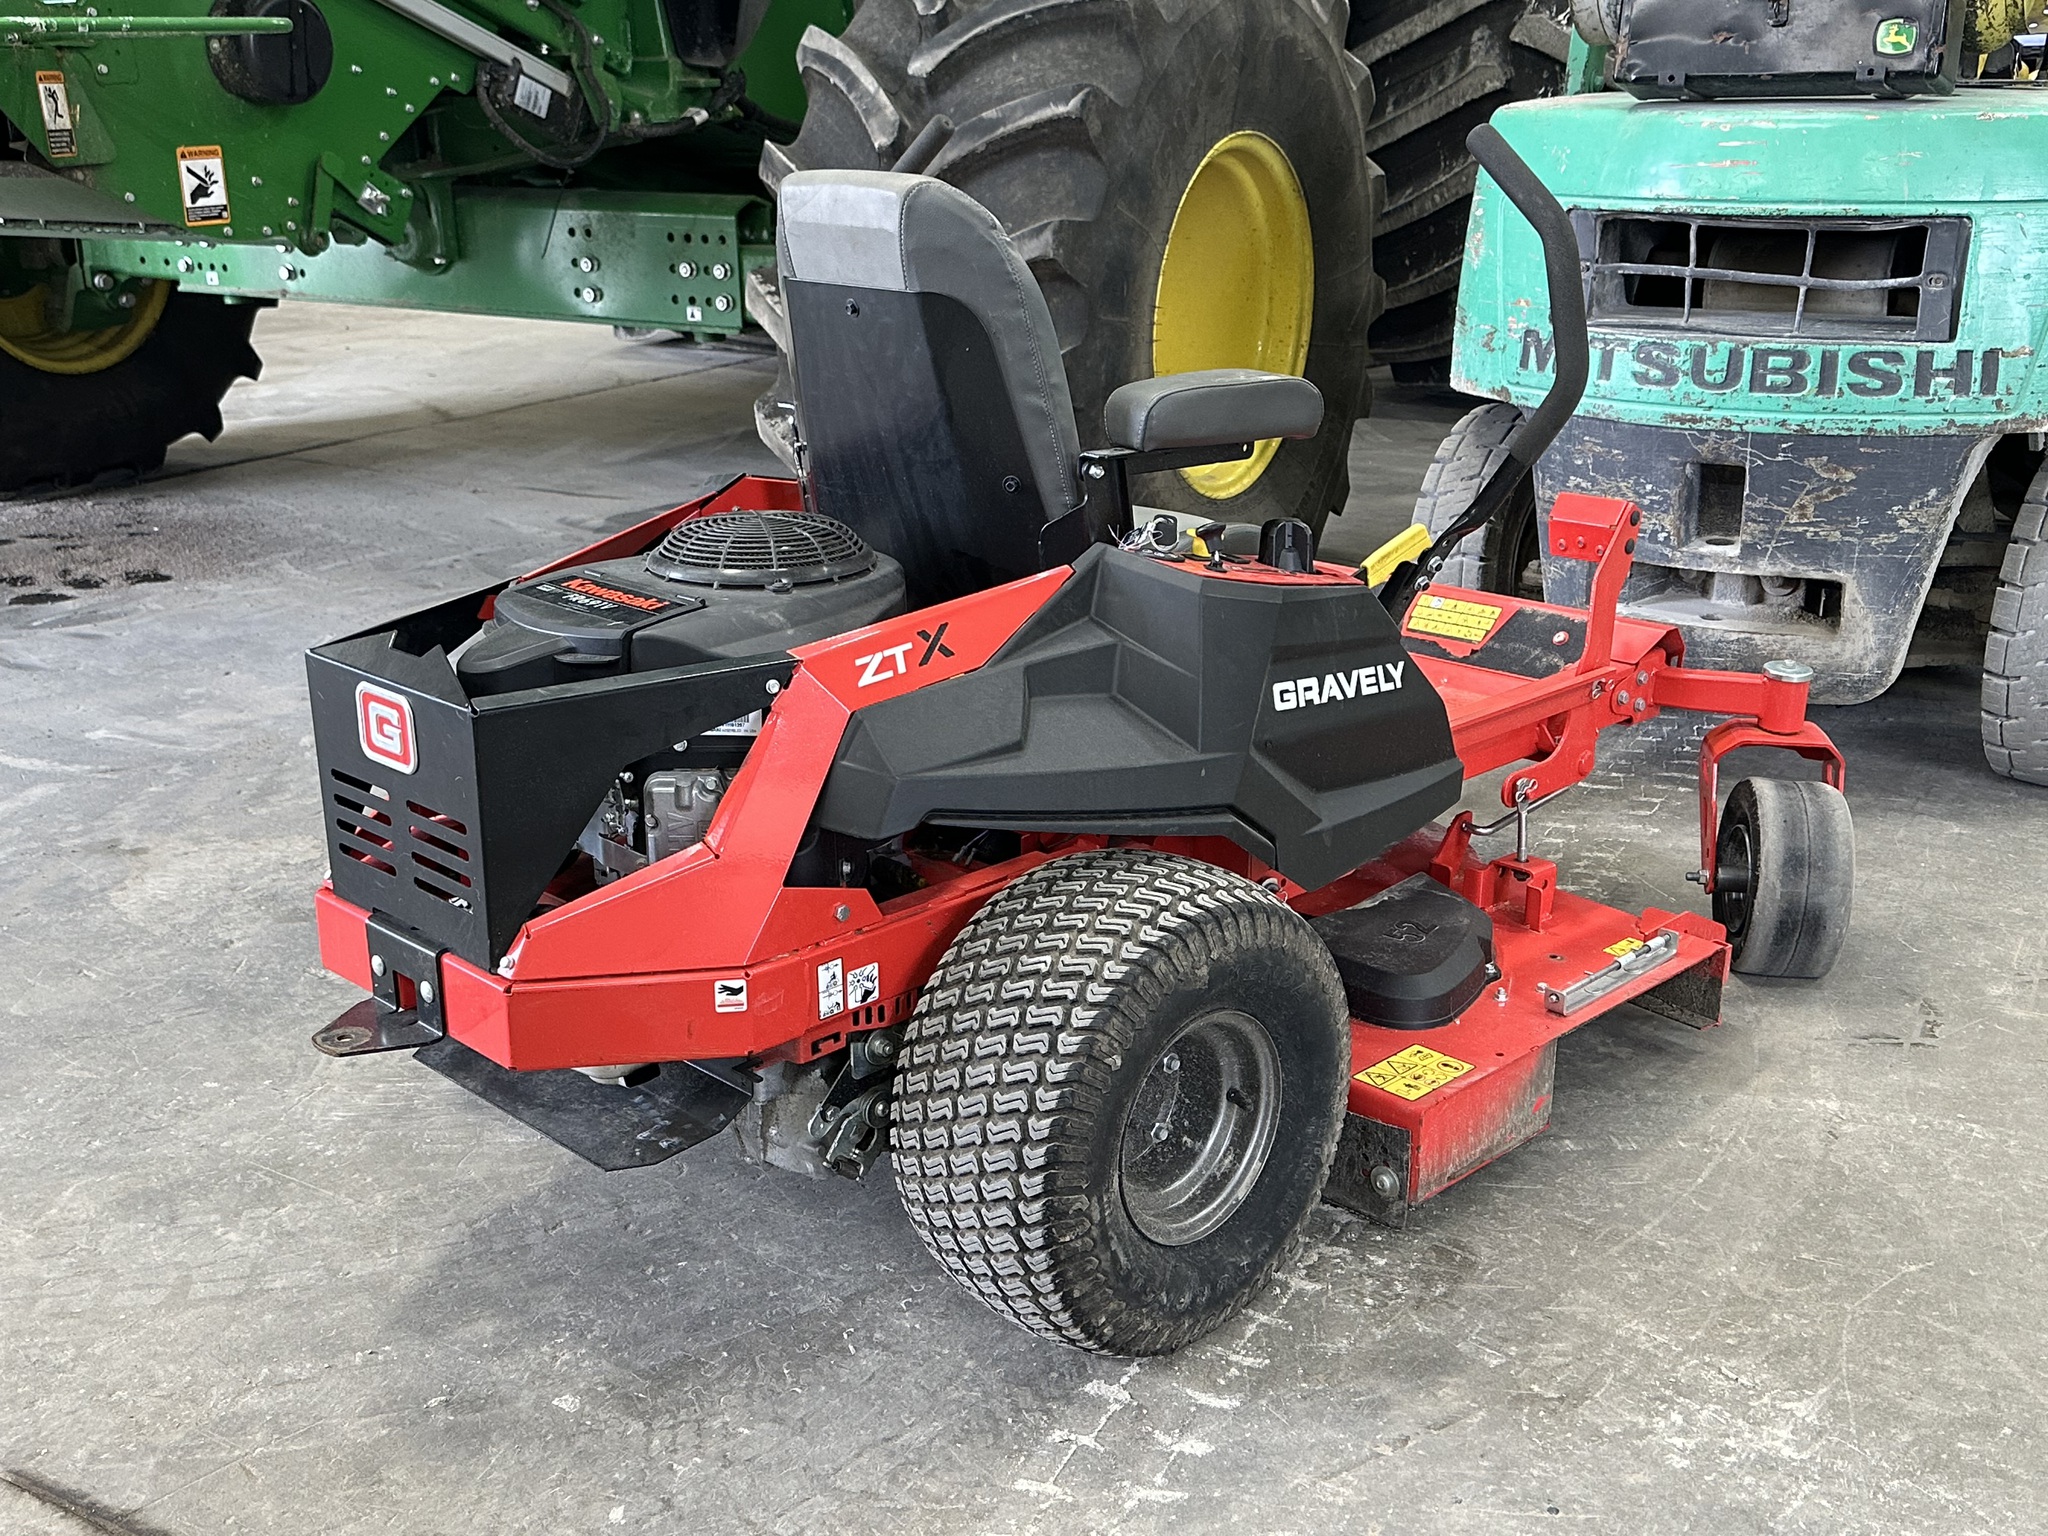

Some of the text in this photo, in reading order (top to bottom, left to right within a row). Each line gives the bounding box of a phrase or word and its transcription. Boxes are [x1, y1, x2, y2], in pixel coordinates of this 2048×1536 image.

[187, 149, 220, 157] WARNING
[1519, 329, 2001, 398] MTSUBISHI
[561, 578, 671, 611] Kawasaki
[1272, 660, 1405, 712] GRAVELY
